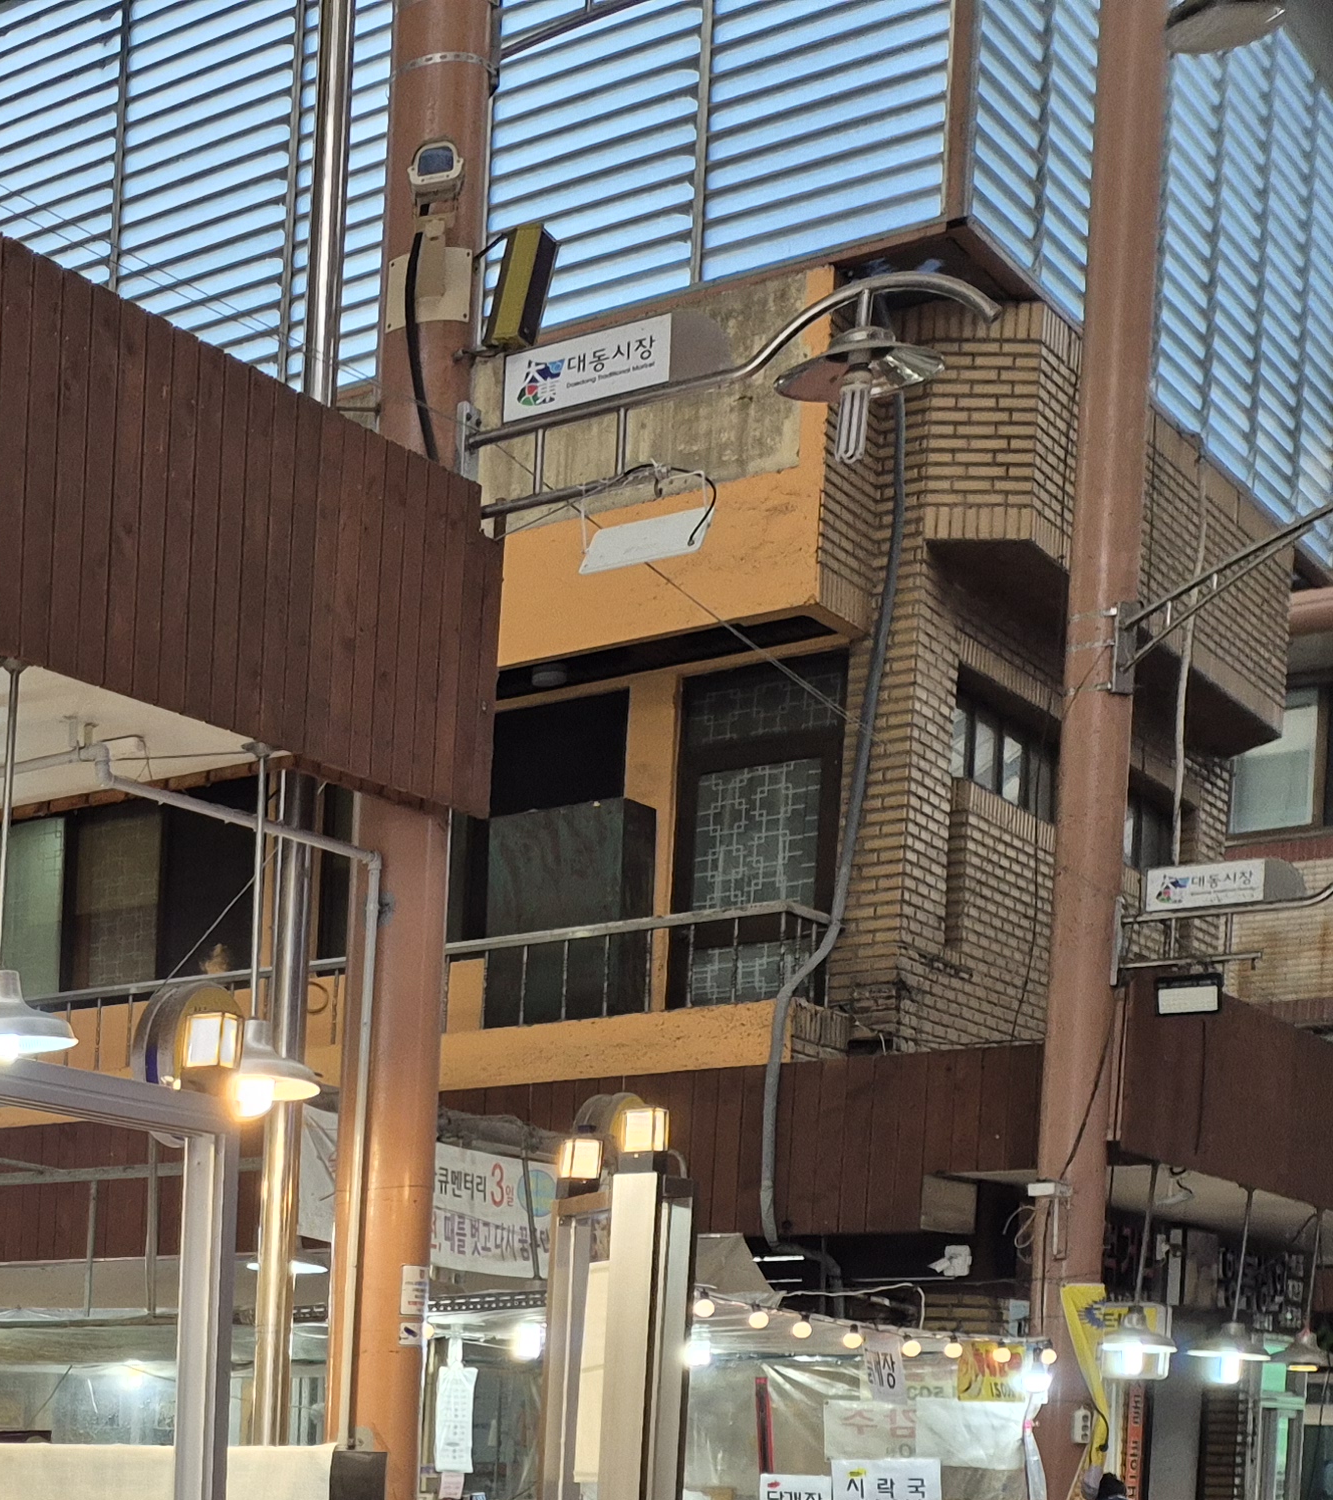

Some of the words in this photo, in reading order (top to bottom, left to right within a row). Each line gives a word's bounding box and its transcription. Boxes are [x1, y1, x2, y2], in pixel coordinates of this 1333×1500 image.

[566, 335, 655, 374] 대동시장
[632, 361, 655, 372] Market
[1191, 869, 1254, 888] 대동시장
[435, 1166, 487, 1203] 큐멘터리
[443, 1213, 467, 1255] 때를
